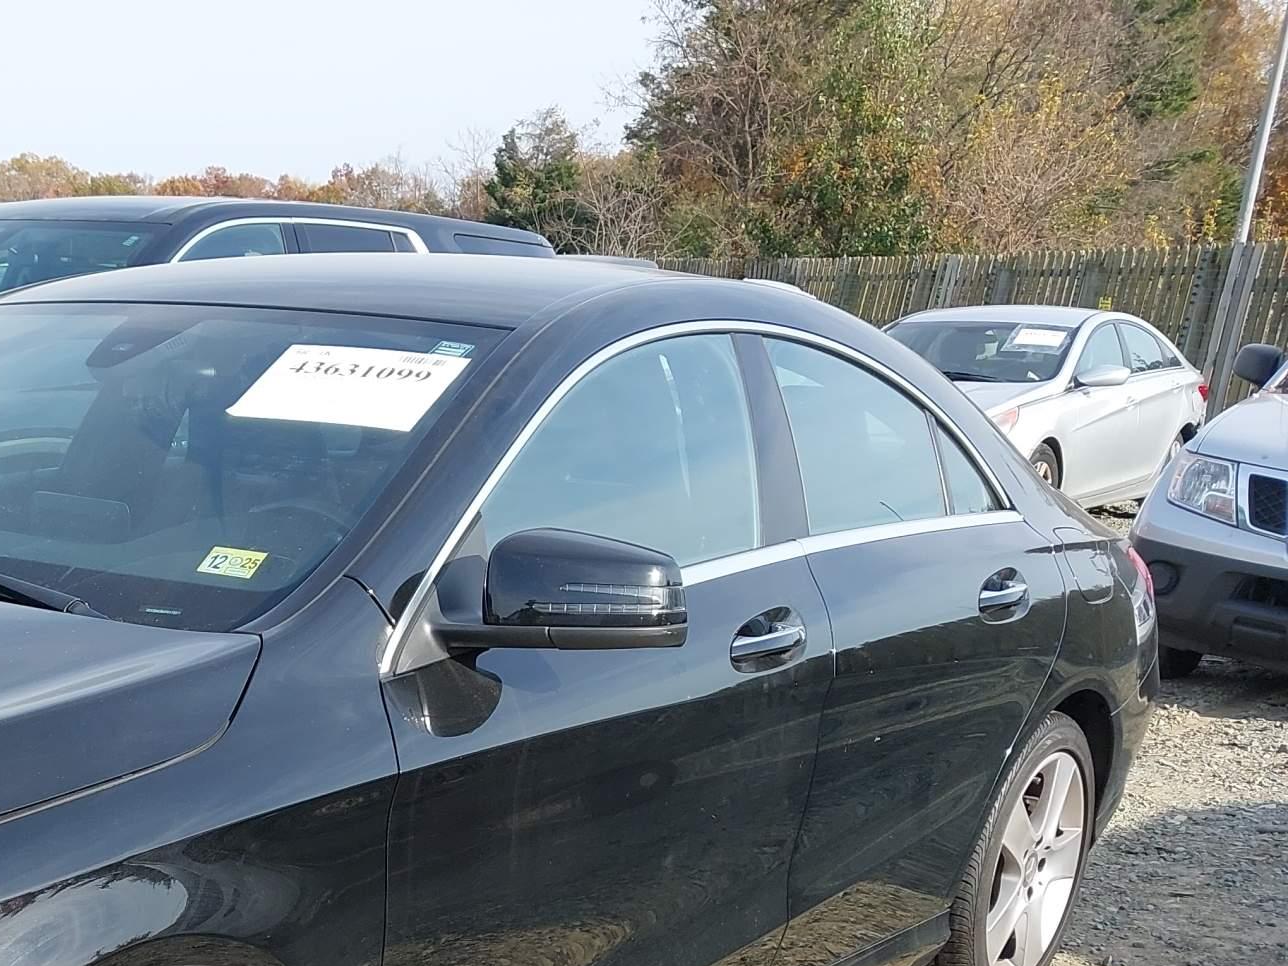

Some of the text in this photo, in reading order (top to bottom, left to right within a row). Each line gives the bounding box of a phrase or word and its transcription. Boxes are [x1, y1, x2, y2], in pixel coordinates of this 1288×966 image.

[289, 360, 432, 382] 43631099
[206, 554, 260, 570] 12 25
